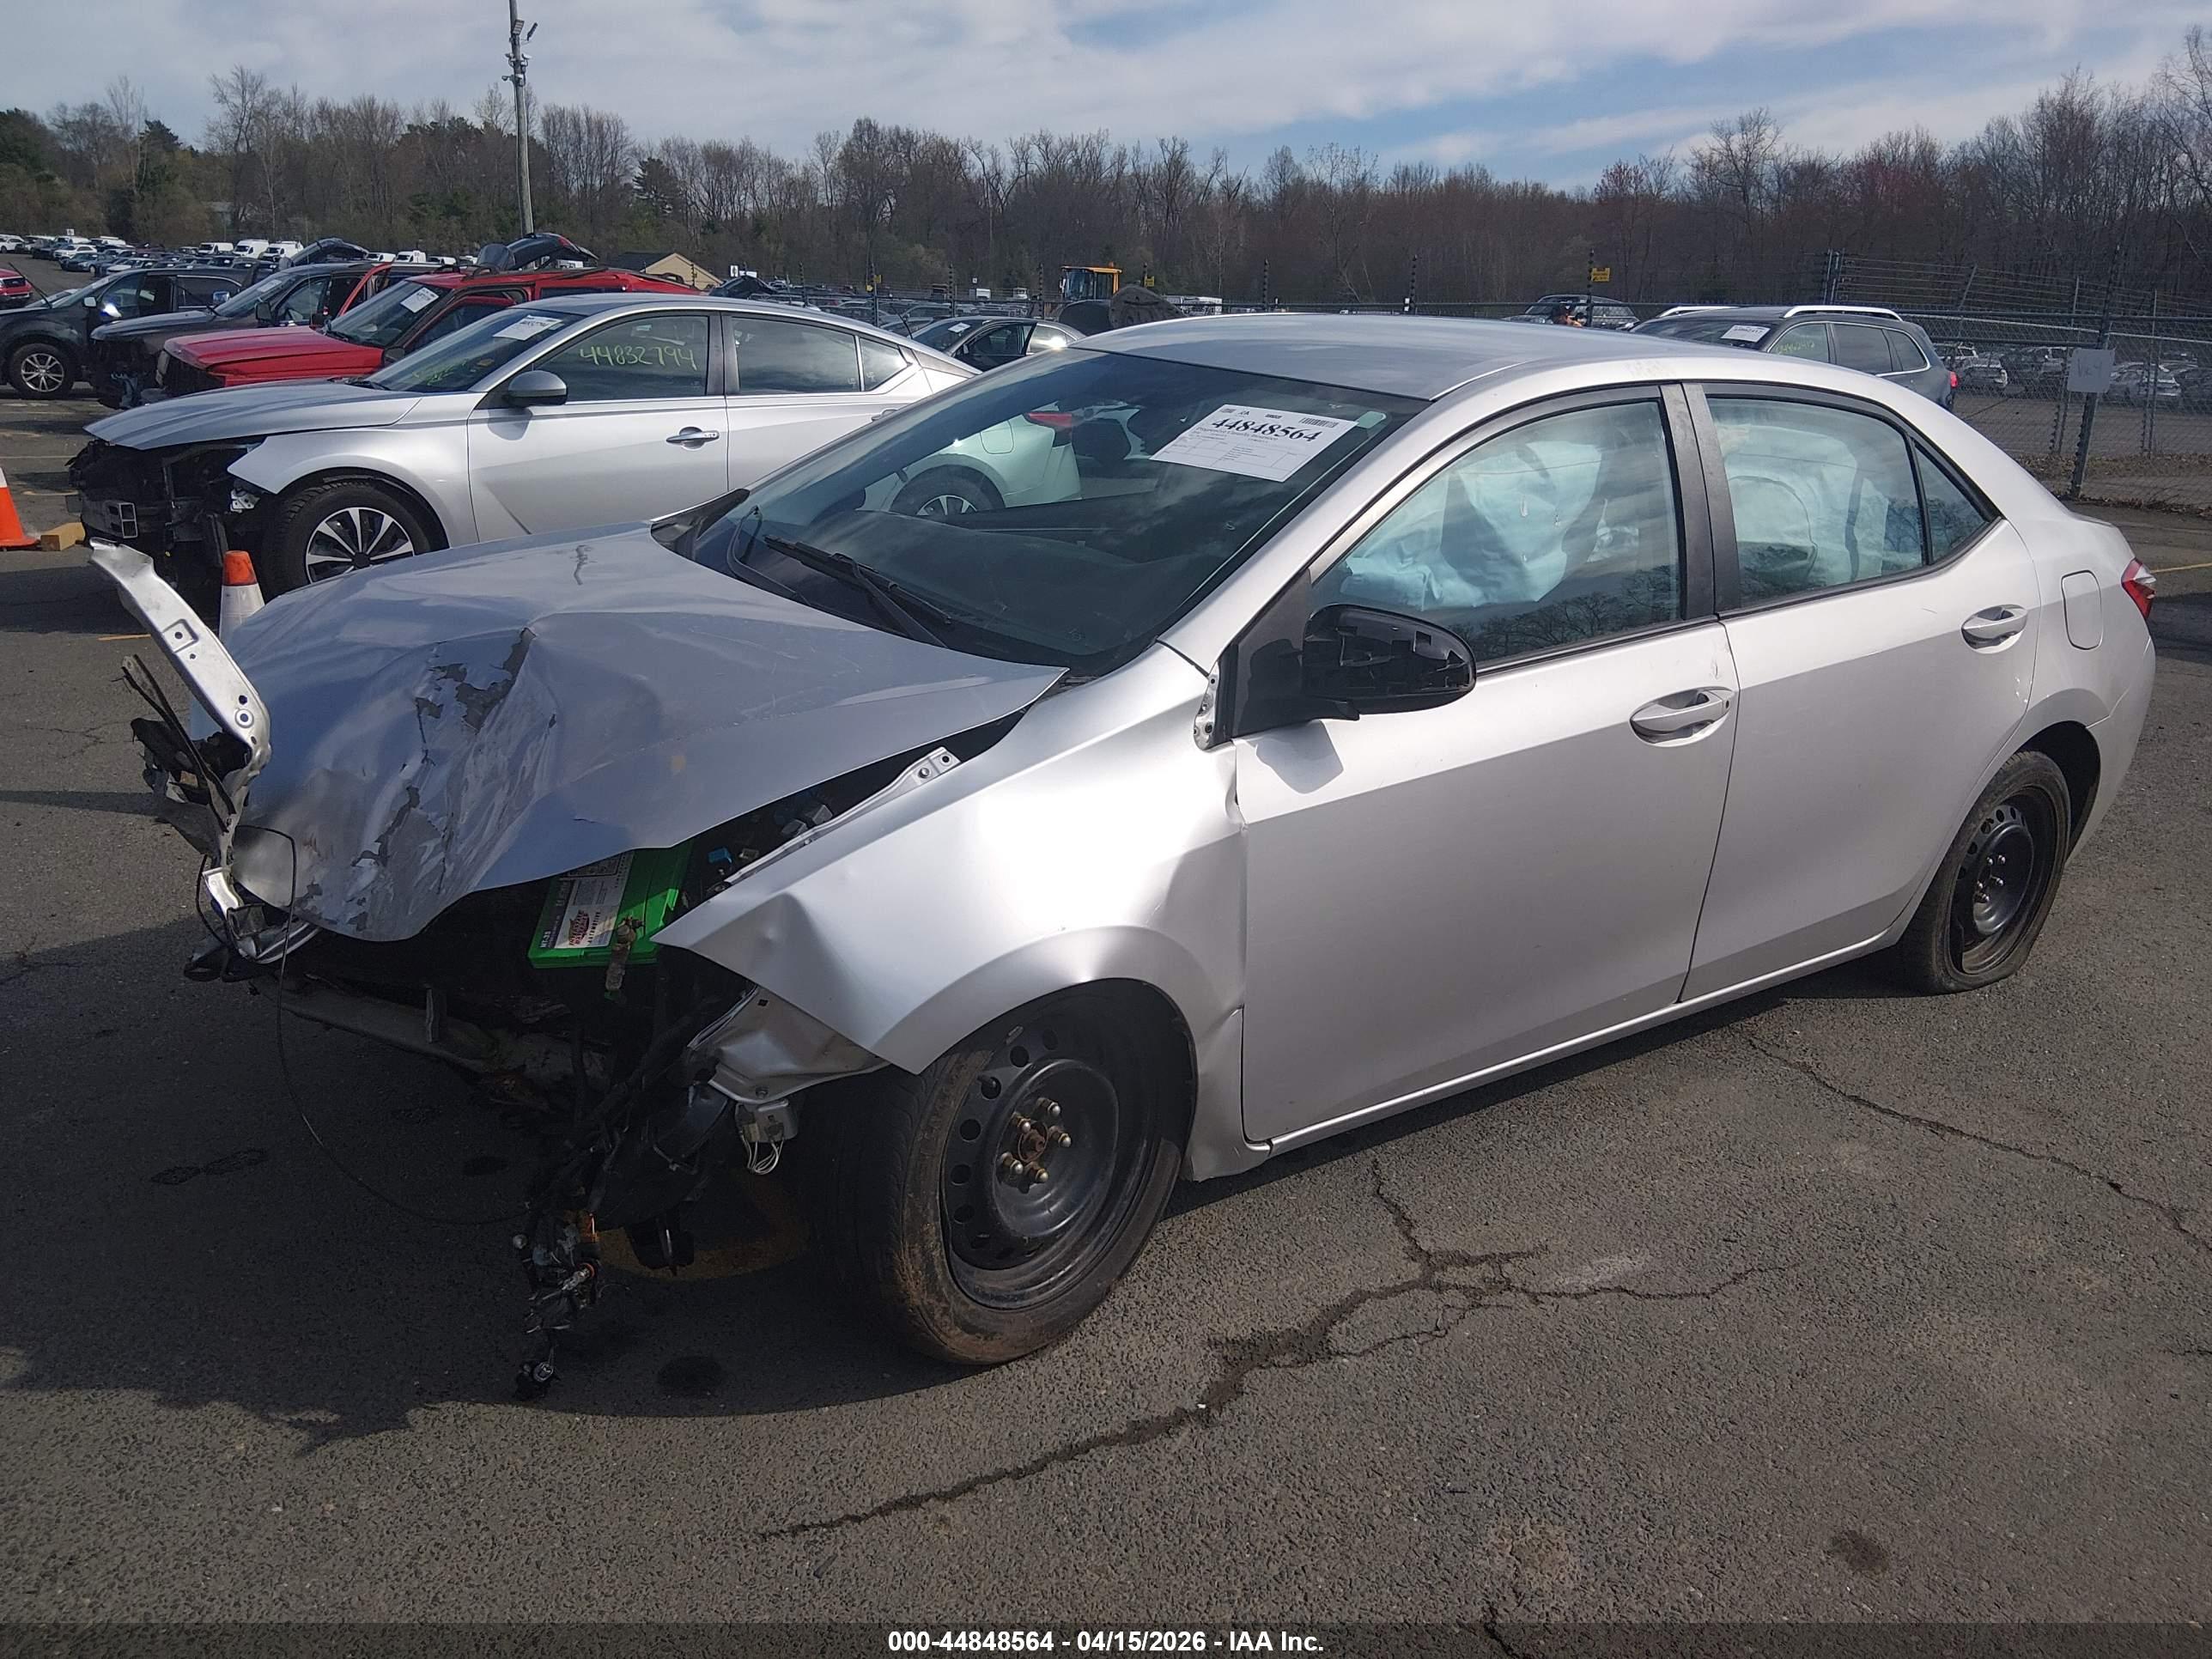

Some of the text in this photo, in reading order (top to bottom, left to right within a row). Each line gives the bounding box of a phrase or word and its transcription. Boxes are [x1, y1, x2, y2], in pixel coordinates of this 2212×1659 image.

[580, 345, 697, 371] 44832794
[1212, 417, 1322, 442] 44848564
[587, 911, 601, 944] AUTOMOTIVE
